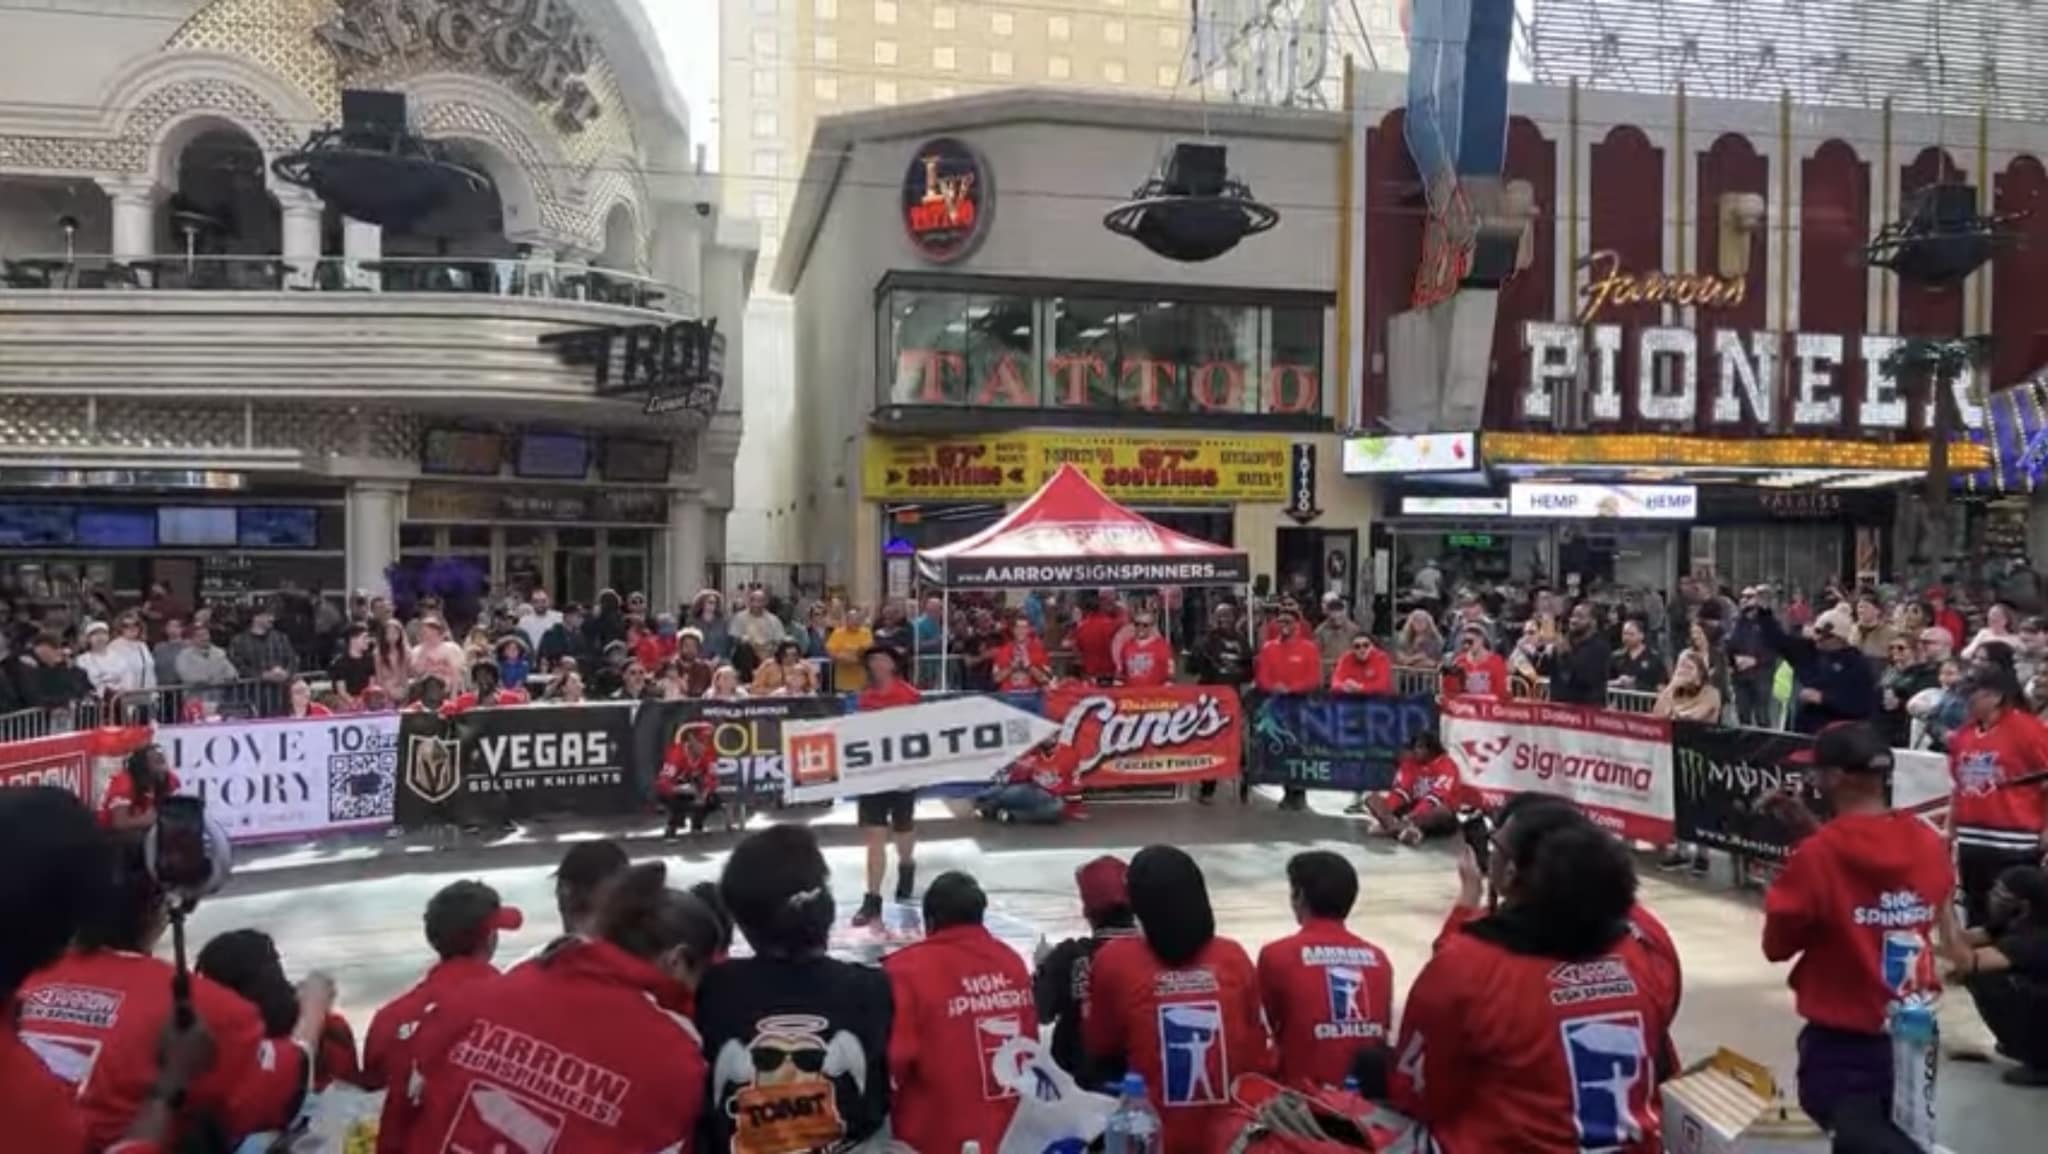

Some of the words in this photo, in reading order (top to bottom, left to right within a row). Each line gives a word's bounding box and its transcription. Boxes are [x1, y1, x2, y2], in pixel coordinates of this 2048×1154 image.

[1575, 248, 1748, 326] Famous
[900, 349, 1319, 412] TATTOO
[1298, 444, 1311, 511] TATTOO
[1531, 495, 1578, 508] HEMP
[957, 563, 1239, 584] www.AARROWSIGNSPINNERS.com
[328, 725, 364, 751] 10
[1060, 693, 1231, 777] Cane's
[1301, 703, 1430, 746] NERD
[173, 730, 305, 769] LOVE
[479, 731, 609, 777] VEGAS
[185, 771, 310, 806] TORY
[468, 778, 536, 792] GOLDEN
[543, 773, 622, 787] KNIGHTS
[1286, 759, 1332, 780] THE
